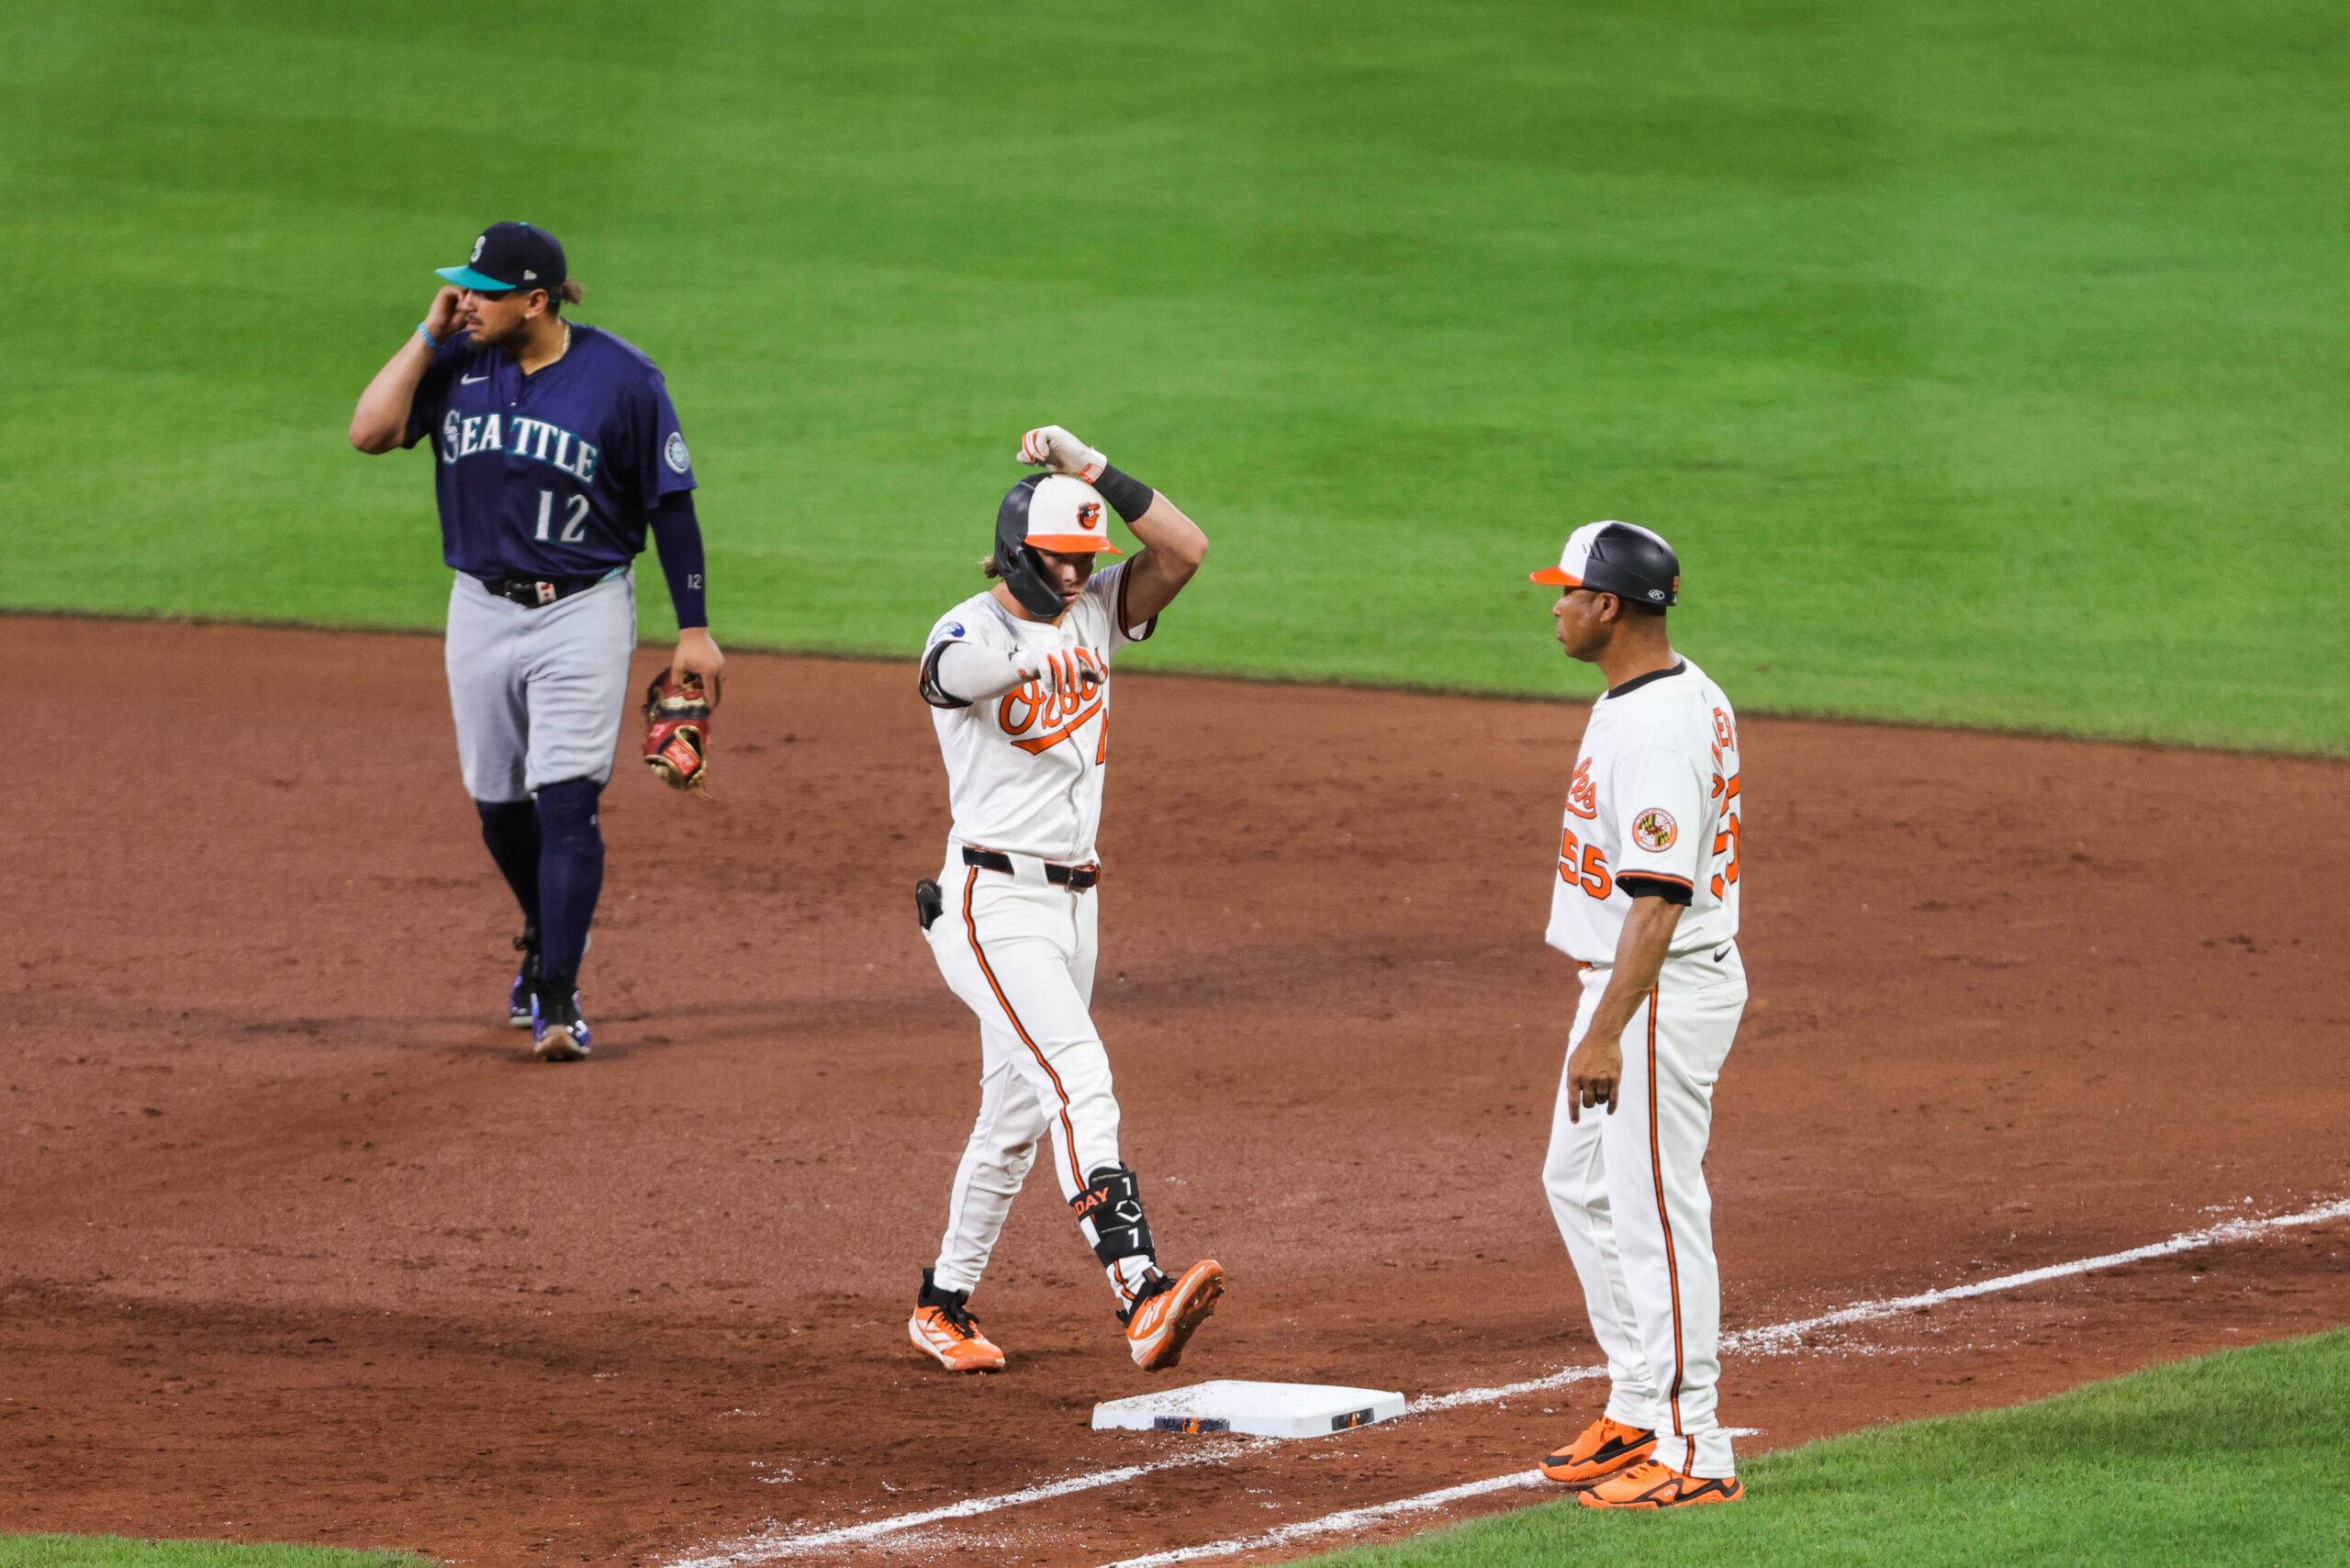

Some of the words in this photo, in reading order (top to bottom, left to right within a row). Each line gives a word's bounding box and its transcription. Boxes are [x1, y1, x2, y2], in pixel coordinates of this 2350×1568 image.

[442, 409, 599, 484] SEATTLE
[534, 489, 589, 543] 12
[688, 574, 702, 588] 12
[1559, 827, 1613, 902] 55
